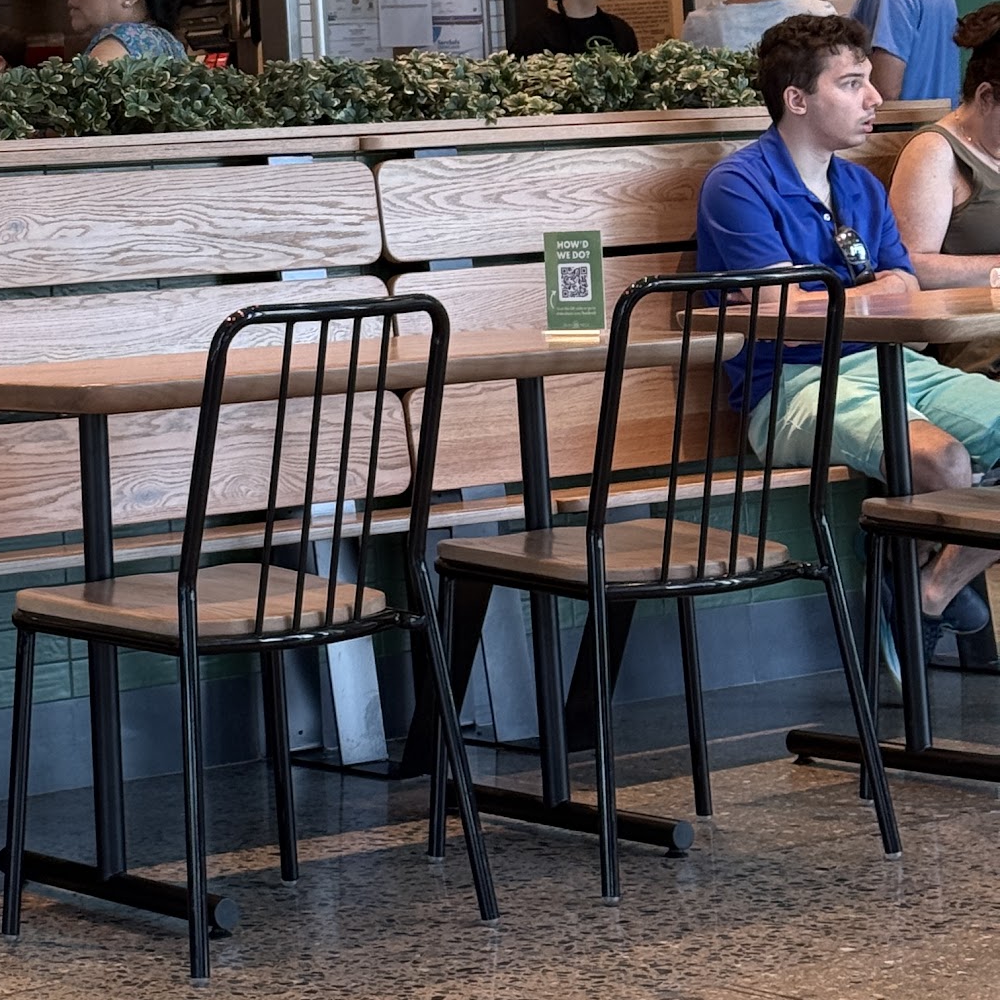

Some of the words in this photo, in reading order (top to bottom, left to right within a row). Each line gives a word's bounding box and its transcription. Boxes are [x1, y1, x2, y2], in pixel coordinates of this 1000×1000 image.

[556, 240, 589, 249] HOW'D
[556, 251, 571, 260] WE
[572, 250, 591, 259] DO?
